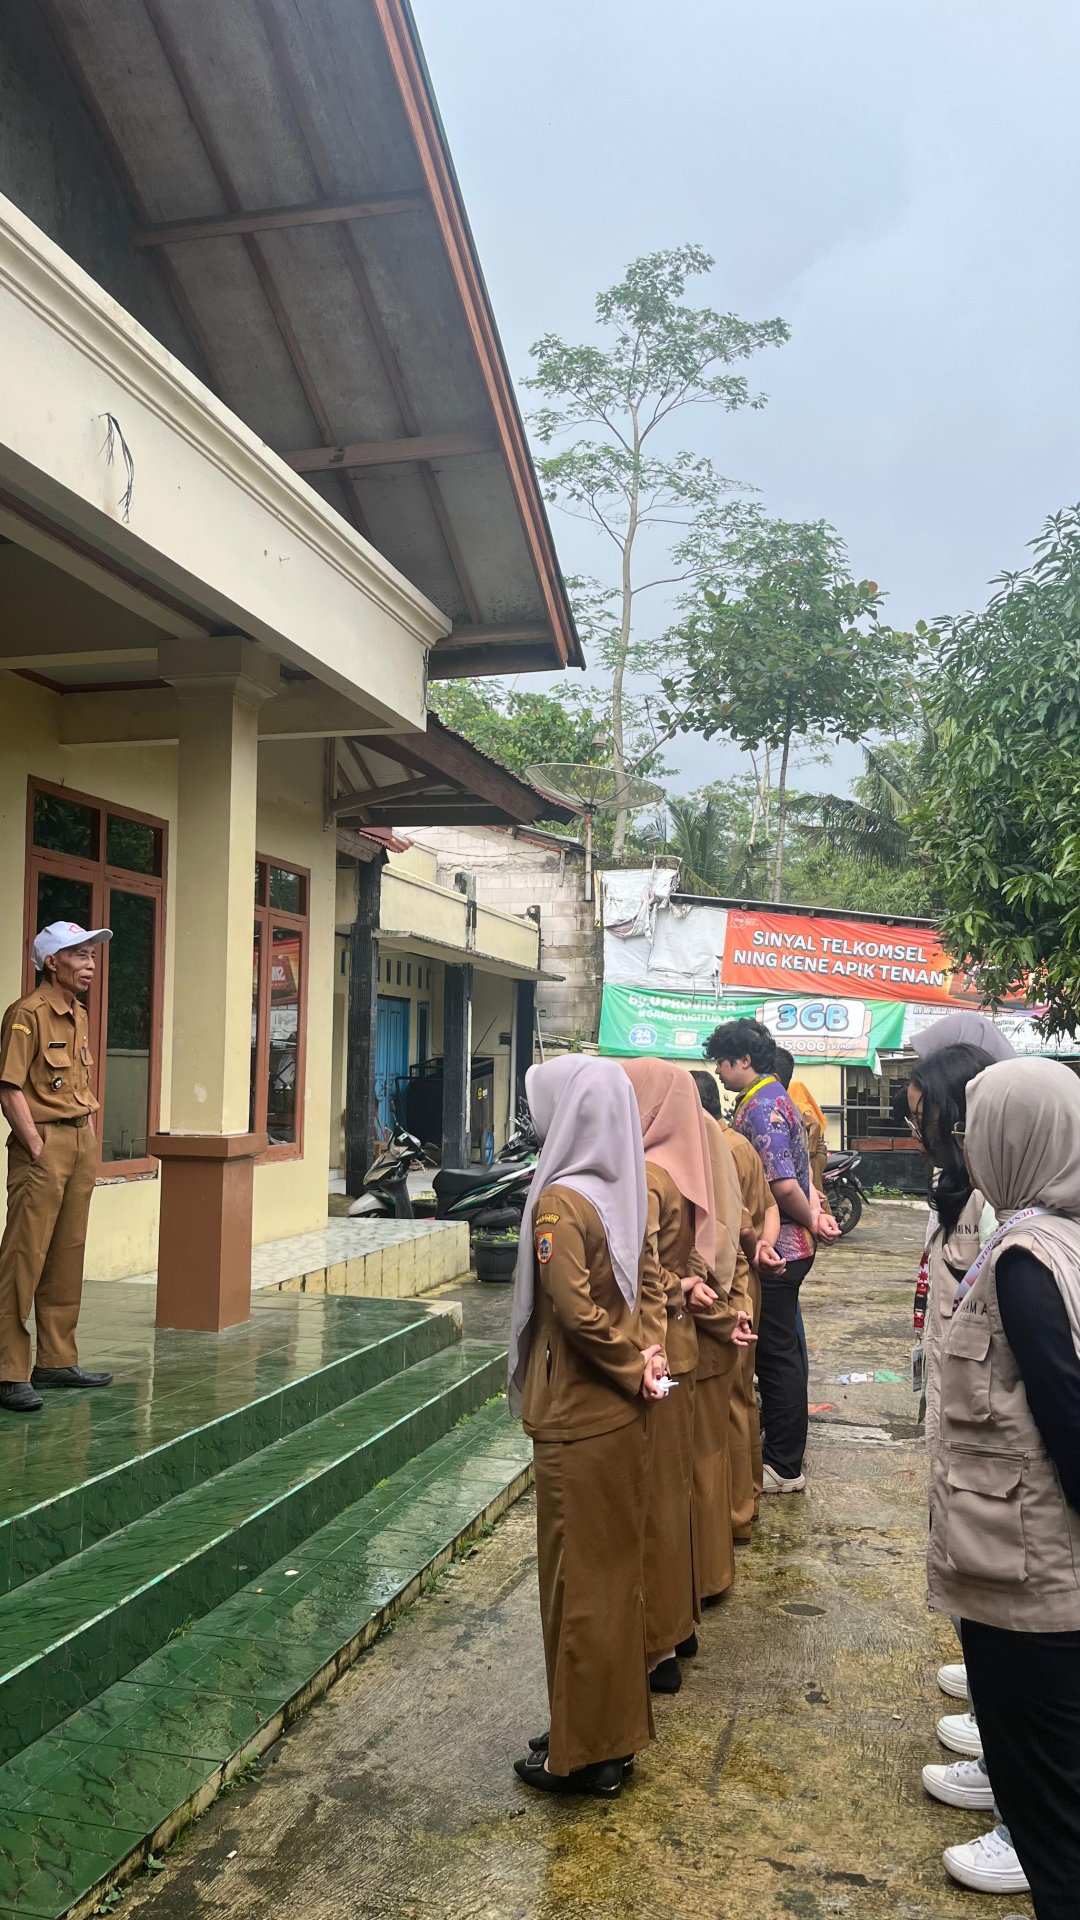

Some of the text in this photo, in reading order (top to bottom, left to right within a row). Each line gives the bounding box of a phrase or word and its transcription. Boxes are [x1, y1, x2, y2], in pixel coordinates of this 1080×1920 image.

[752, 930, 928, 963] SINYAL TELKOMSEL
[733, 949, 944, 986] NING KENE APIK TENAN
